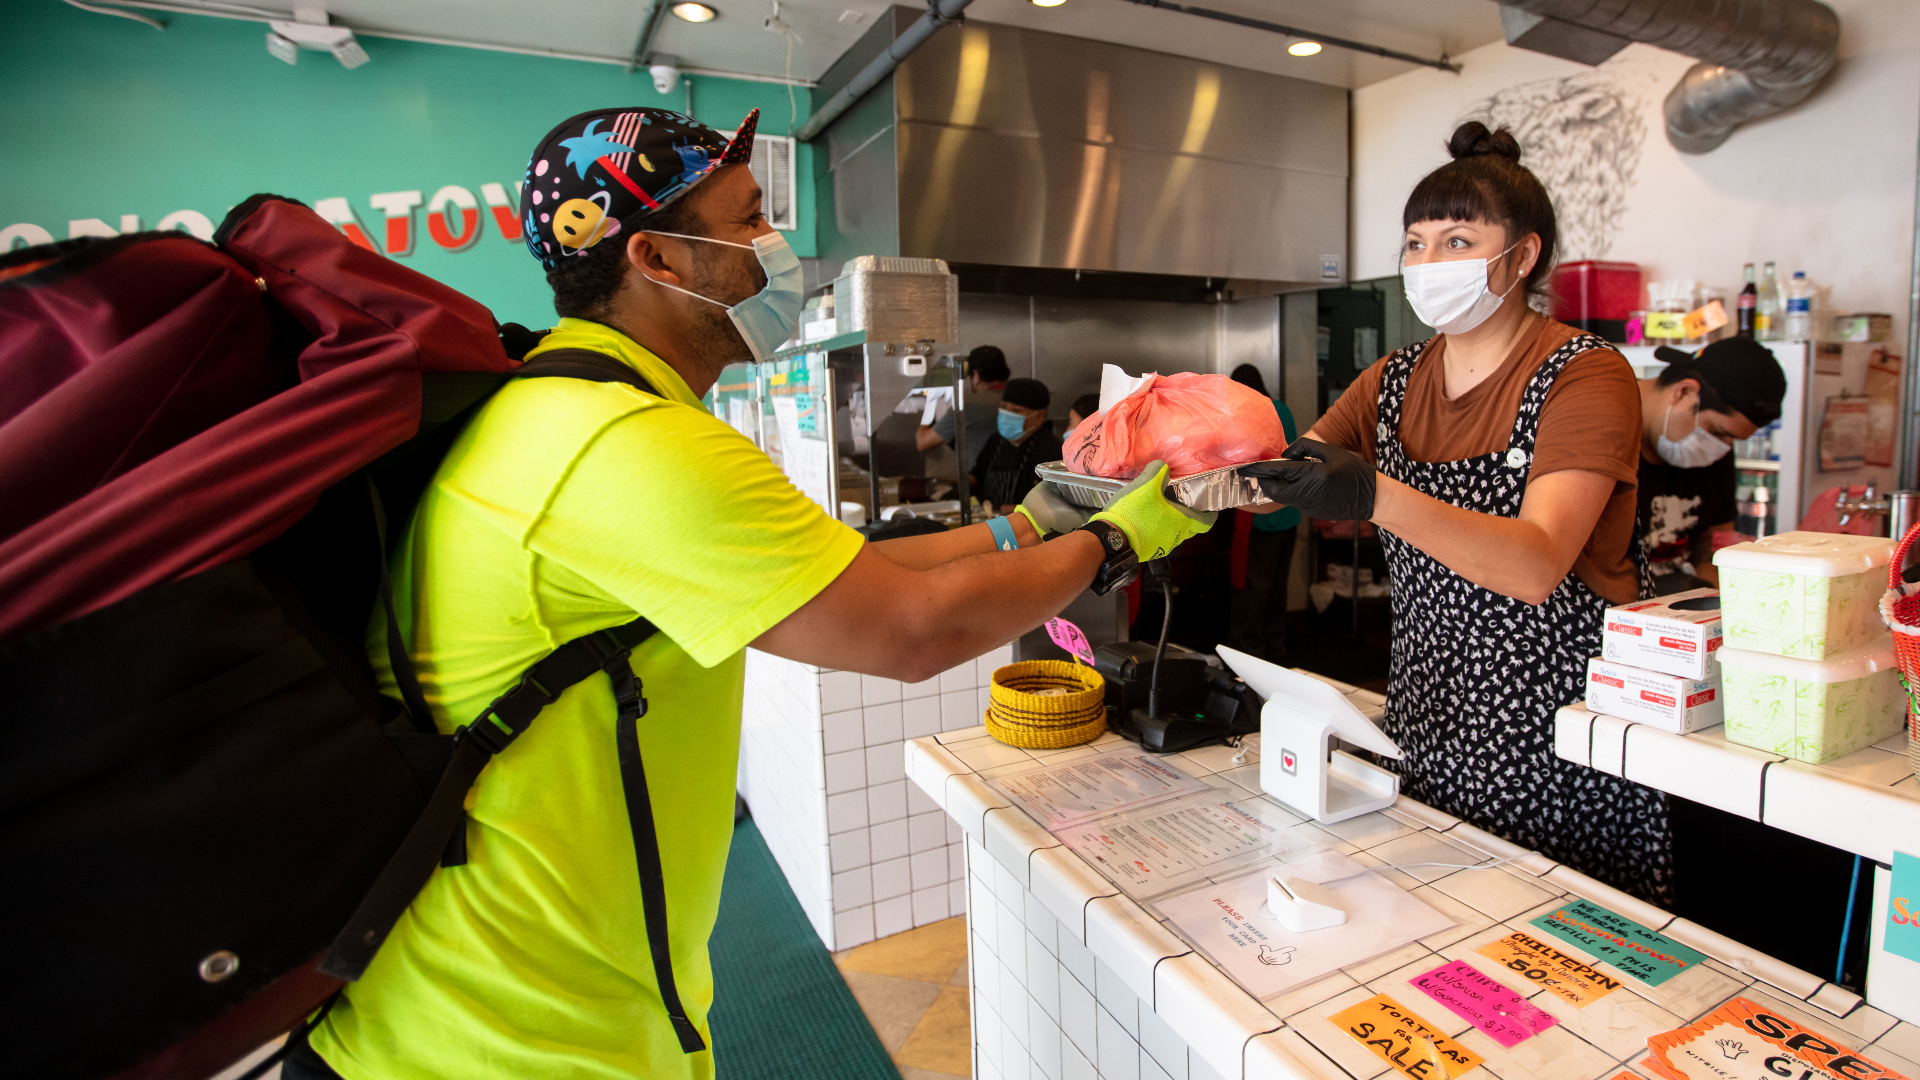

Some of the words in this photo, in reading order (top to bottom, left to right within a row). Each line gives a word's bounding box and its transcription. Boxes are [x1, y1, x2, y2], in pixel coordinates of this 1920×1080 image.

[1613, 622, 1637, 636] Classic
[1617, 616, 1635, 625] Sysco
[1713, 627, 1722, 636] Sys
[1710, 638, 1723, 650] Clas
[1596, 674, 1619, 688] Classic
[1600, 667, 1617, 677] Sysco
[1690, 692, 1711, 705] Classic
[1693, 682, 1708, 692] Sysco
[1212, 898, 1244, 920] PLEASE
[1242, 922, 1268, 941] INSERT
[1221, 916, 1239, 930] YOUR
[1239, 930, 1257, 944] CARD
[1571, 908, 1629, 938] OFFERING
[1577, 903, 1600, 913] WE
[1600, 914, 1631, 928] ARE
[1633, 929, 1668, 945] NOT
[1228, 933, 1247, 947] HERE
[1543, 919, 1597, 945] REFILLS
[1599, 946, 1620, 955] AT
[1622, 956, 1657, 973] THIS
[1548, 910, 1690, 969] SONORATOWN
[1501, 938, 1540, 960] Straight
[1538, 959, 1552, 968] up
[1552, 966, 1591, 990] Sonora
[1510, 932, 1621, 991] CHILTEPIN
[1435, 971, 1485, 1003] W/SALSA
[1455, 965, 1507, 993] CHIPS
[1393, 1028, 1413, 1045] FOR
[1745, 1014, 1899, 1080] SPE
[1350, 1022, 1435, 1080] SALE
